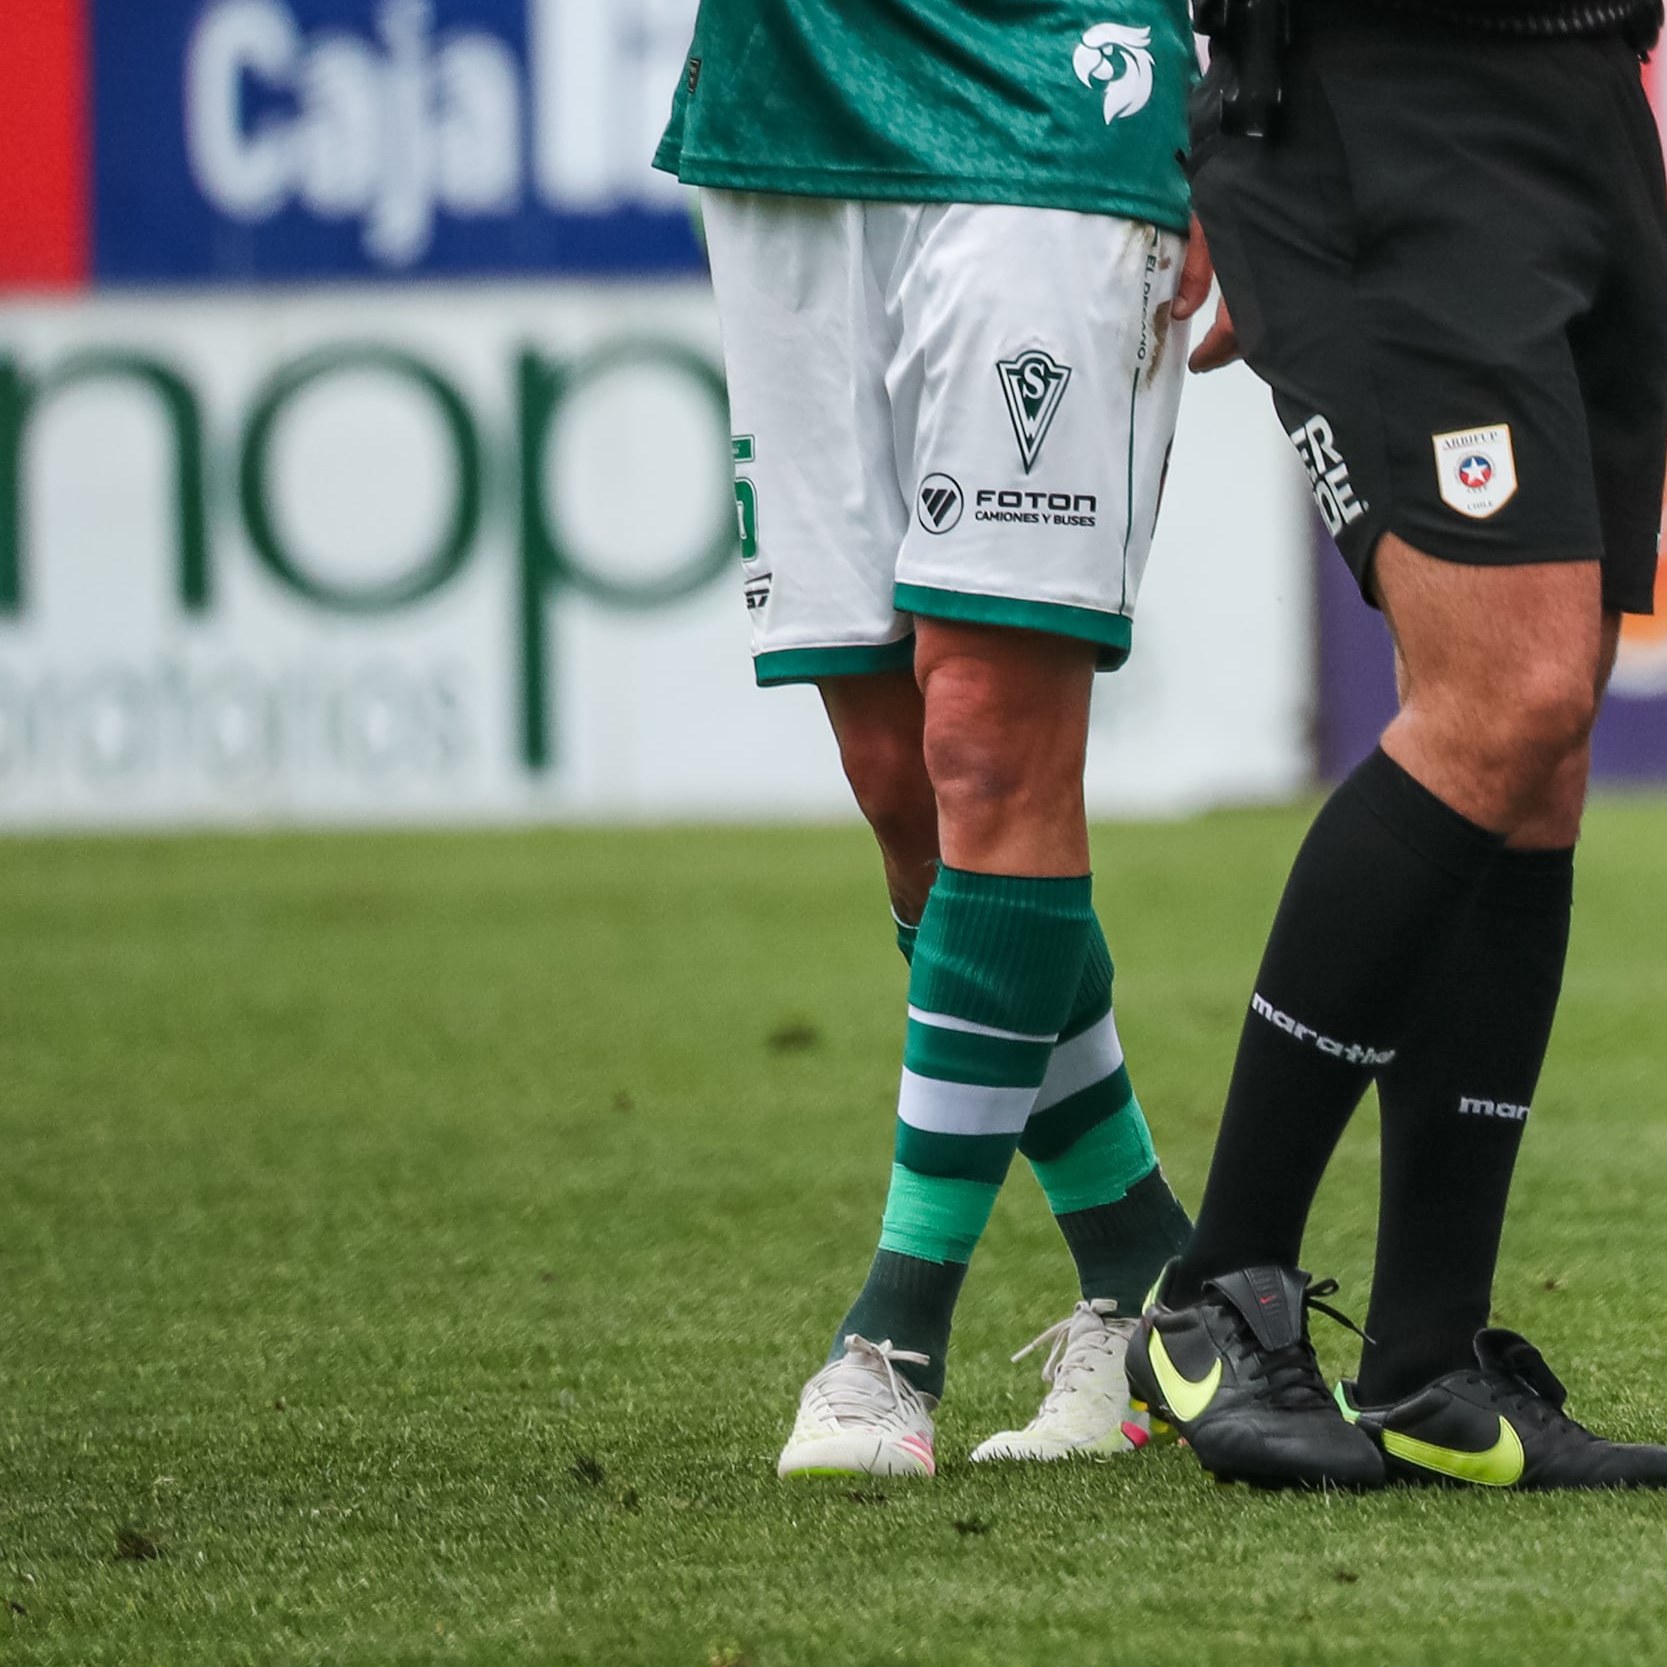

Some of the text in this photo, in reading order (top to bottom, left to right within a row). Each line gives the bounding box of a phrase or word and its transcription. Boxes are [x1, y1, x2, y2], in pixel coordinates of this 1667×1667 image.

[975, 489, 1097, 513] FOTON
[975, 511, 1096, 527] CAMIONES Y BUSES
[1252, 992, 1395, 1065] maratho
